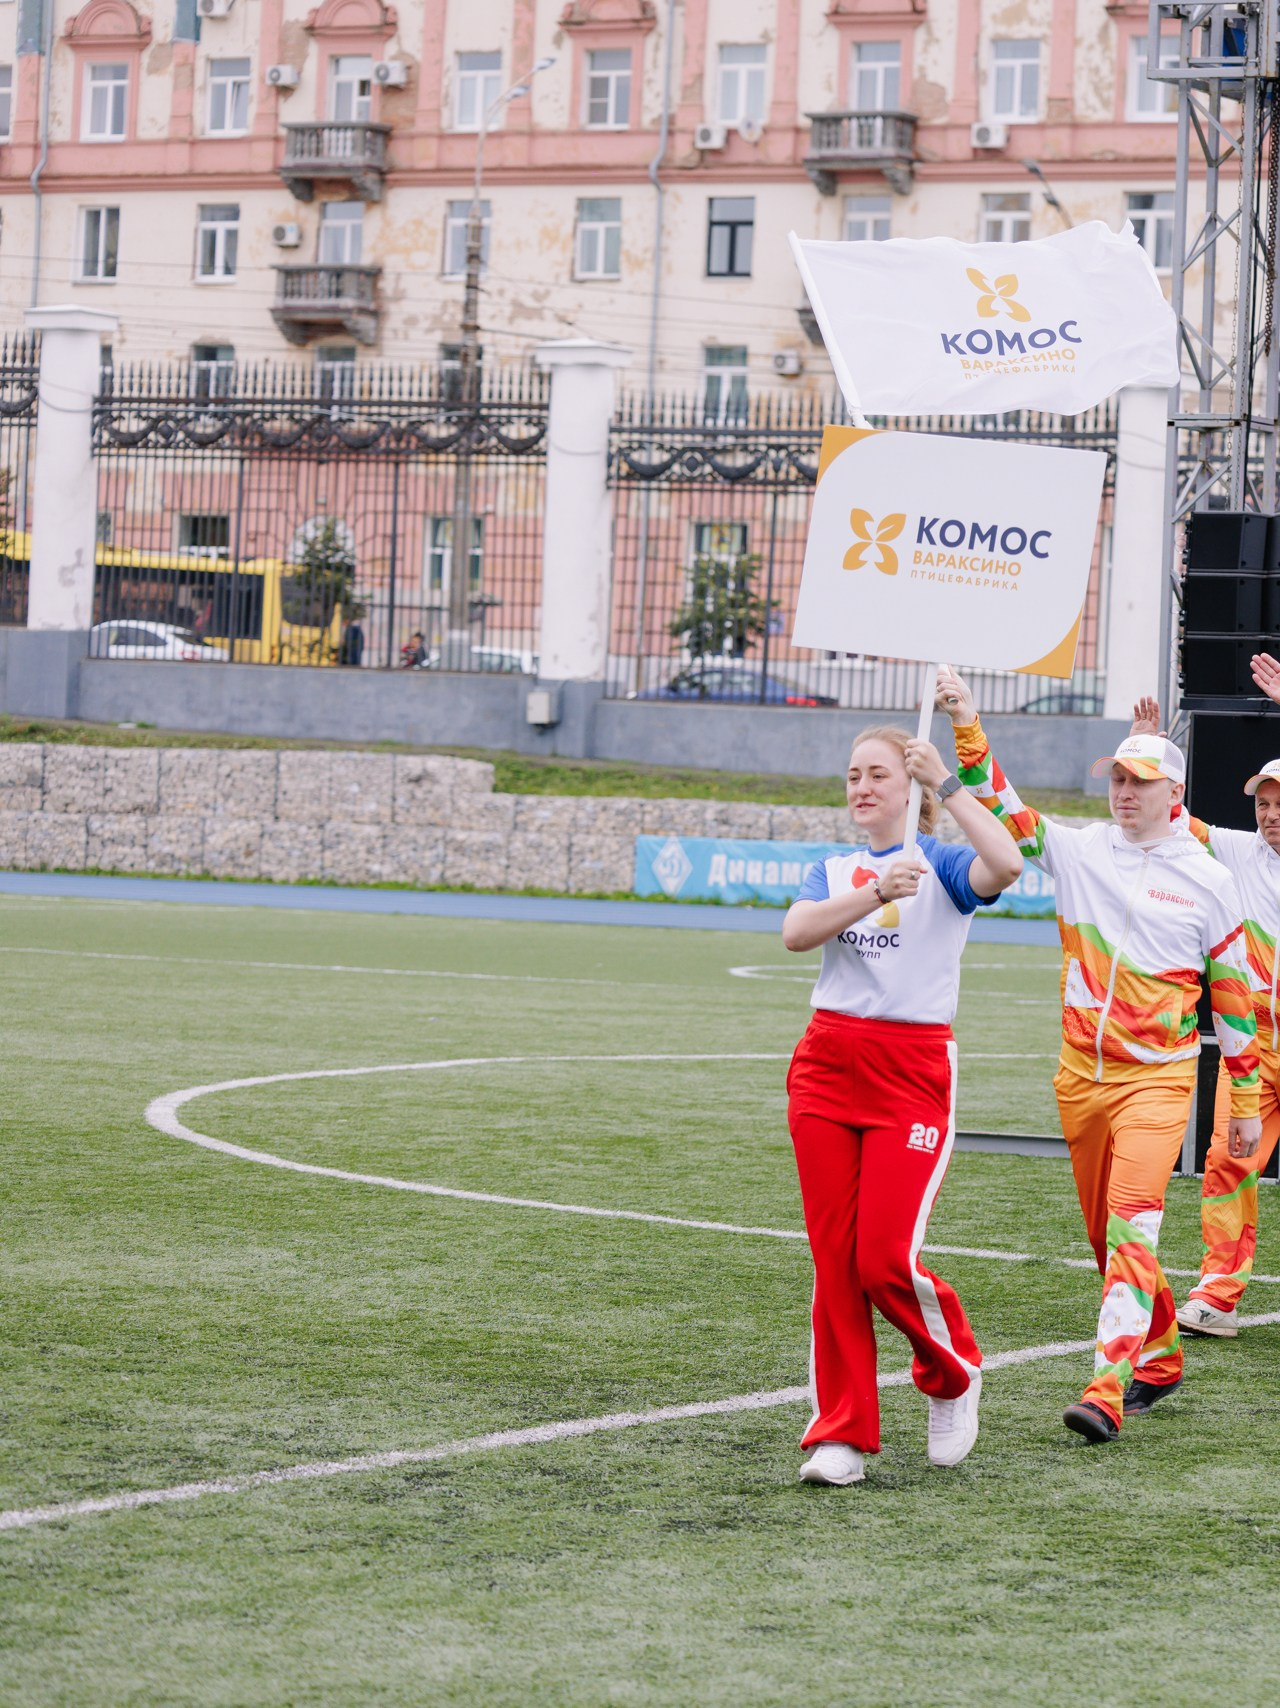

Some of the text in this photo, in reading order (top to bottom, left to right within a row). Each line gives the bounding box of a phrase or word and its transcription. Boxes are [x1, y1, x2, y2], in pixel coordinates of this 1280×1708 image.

[941, 320, 1083, 356] КОМОС
[960, 348, 1076, 372] ВАРАКСИНО
[964, 364, 1076, 380] ПЦЕФАБРИКА
[916, 516, 1053, 559] КОМОС
[912, 550, 1022, 577] ВАРАКСИНО
[910, 569, 1019, 591] ПТИЦЕФАБРИКА
[855, 948, 881, 959] РУПП
[908, 1122, 940, 1150] 20
